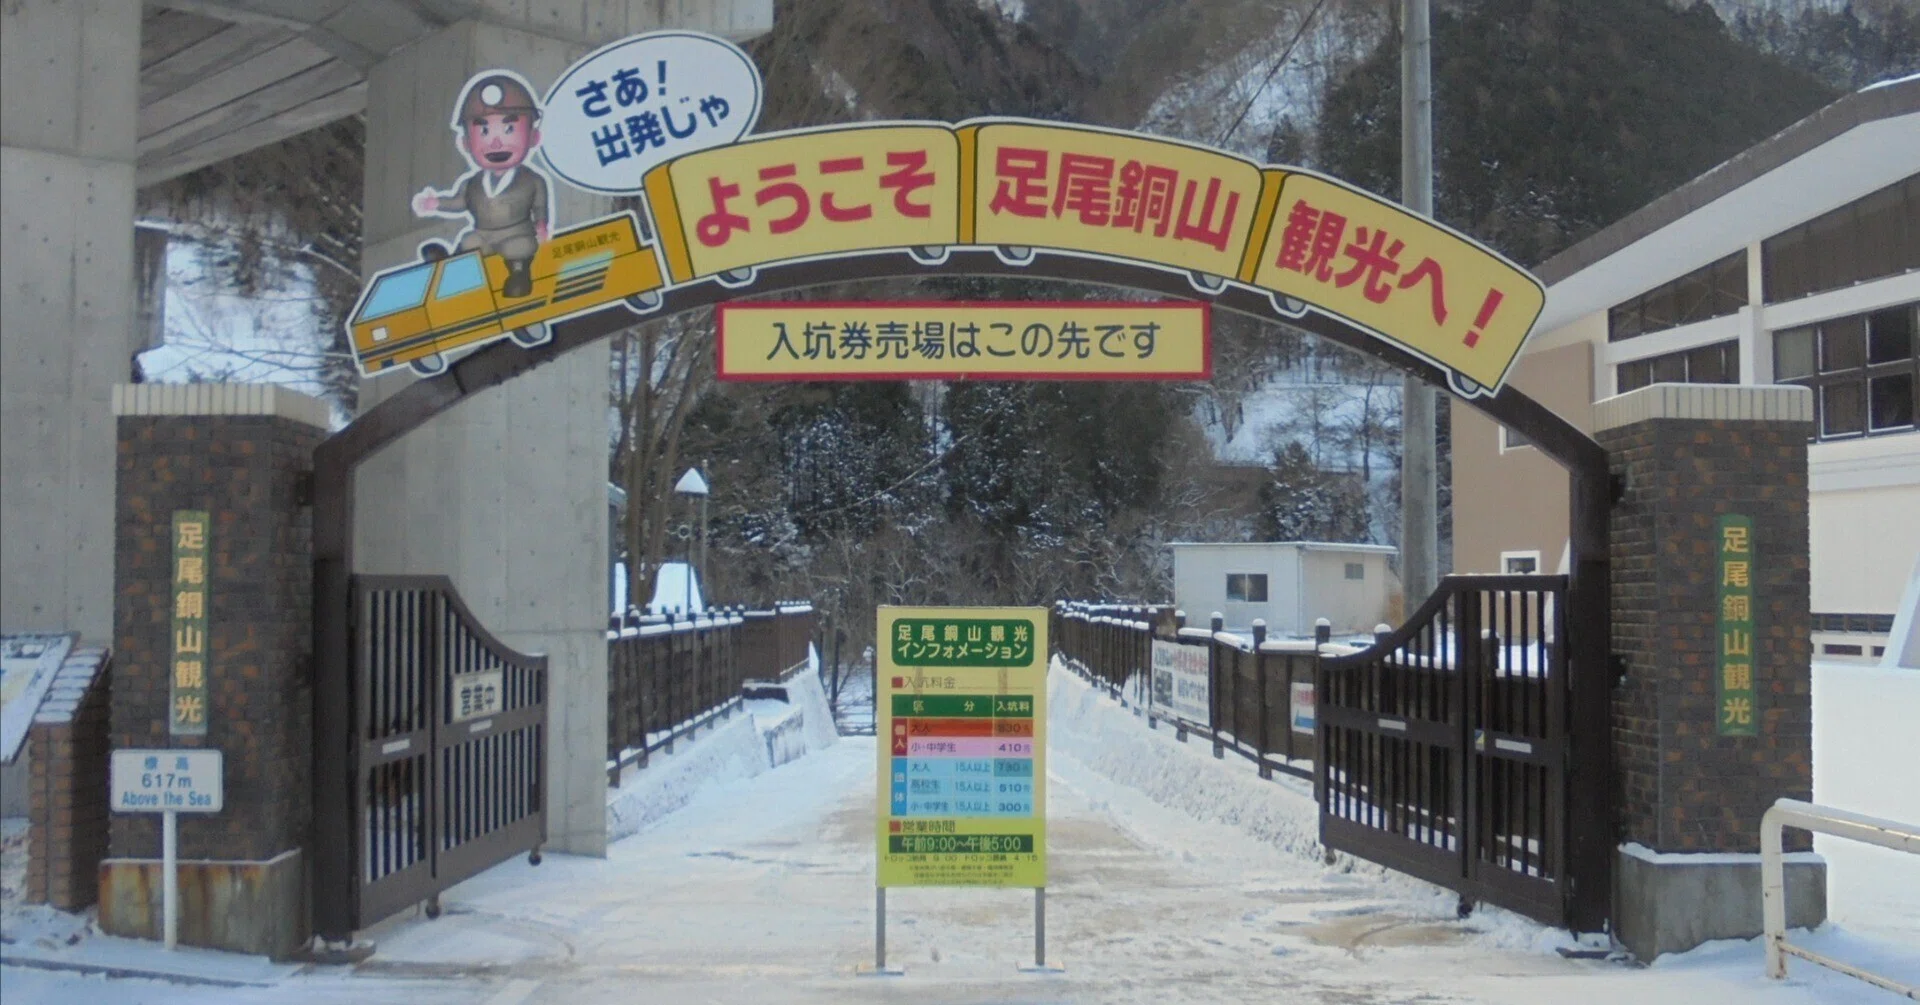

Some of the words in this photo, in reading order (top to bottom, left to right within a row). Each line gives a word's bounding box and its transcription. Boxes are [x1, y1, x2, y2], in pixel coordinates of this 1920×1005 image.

[576, 60, 667, 118] さあ!
[591, 95, 730, 167] 出発じゃ
[695, 150, 936, 246] ようこそ
[988, 147, 1241, 251] 足尾銅山
[1278, 199, 1504, 348] 観光へ!
[767, 320, 1161, 361] 入坑券売場はこの先です
[176, 521, 204, 723] 足尾銅山観光
[898, 624, 1028, 641] 足尾銅山観光
[1722, 526, 1752, 724] 足尾銅山観光
[898, 643, 1028, 659] インフォメーション
[460, 682, 495, 717] 営業中
[996, 701, 1030, 713] 入坑料
[911, 762, 930, 772] 大人
[122, 791, 158, 805] Above
[164, 791, 183, 805] the
[189, 791, 212, 806] Sea
[902, 820, 955, 833] 営業時間
